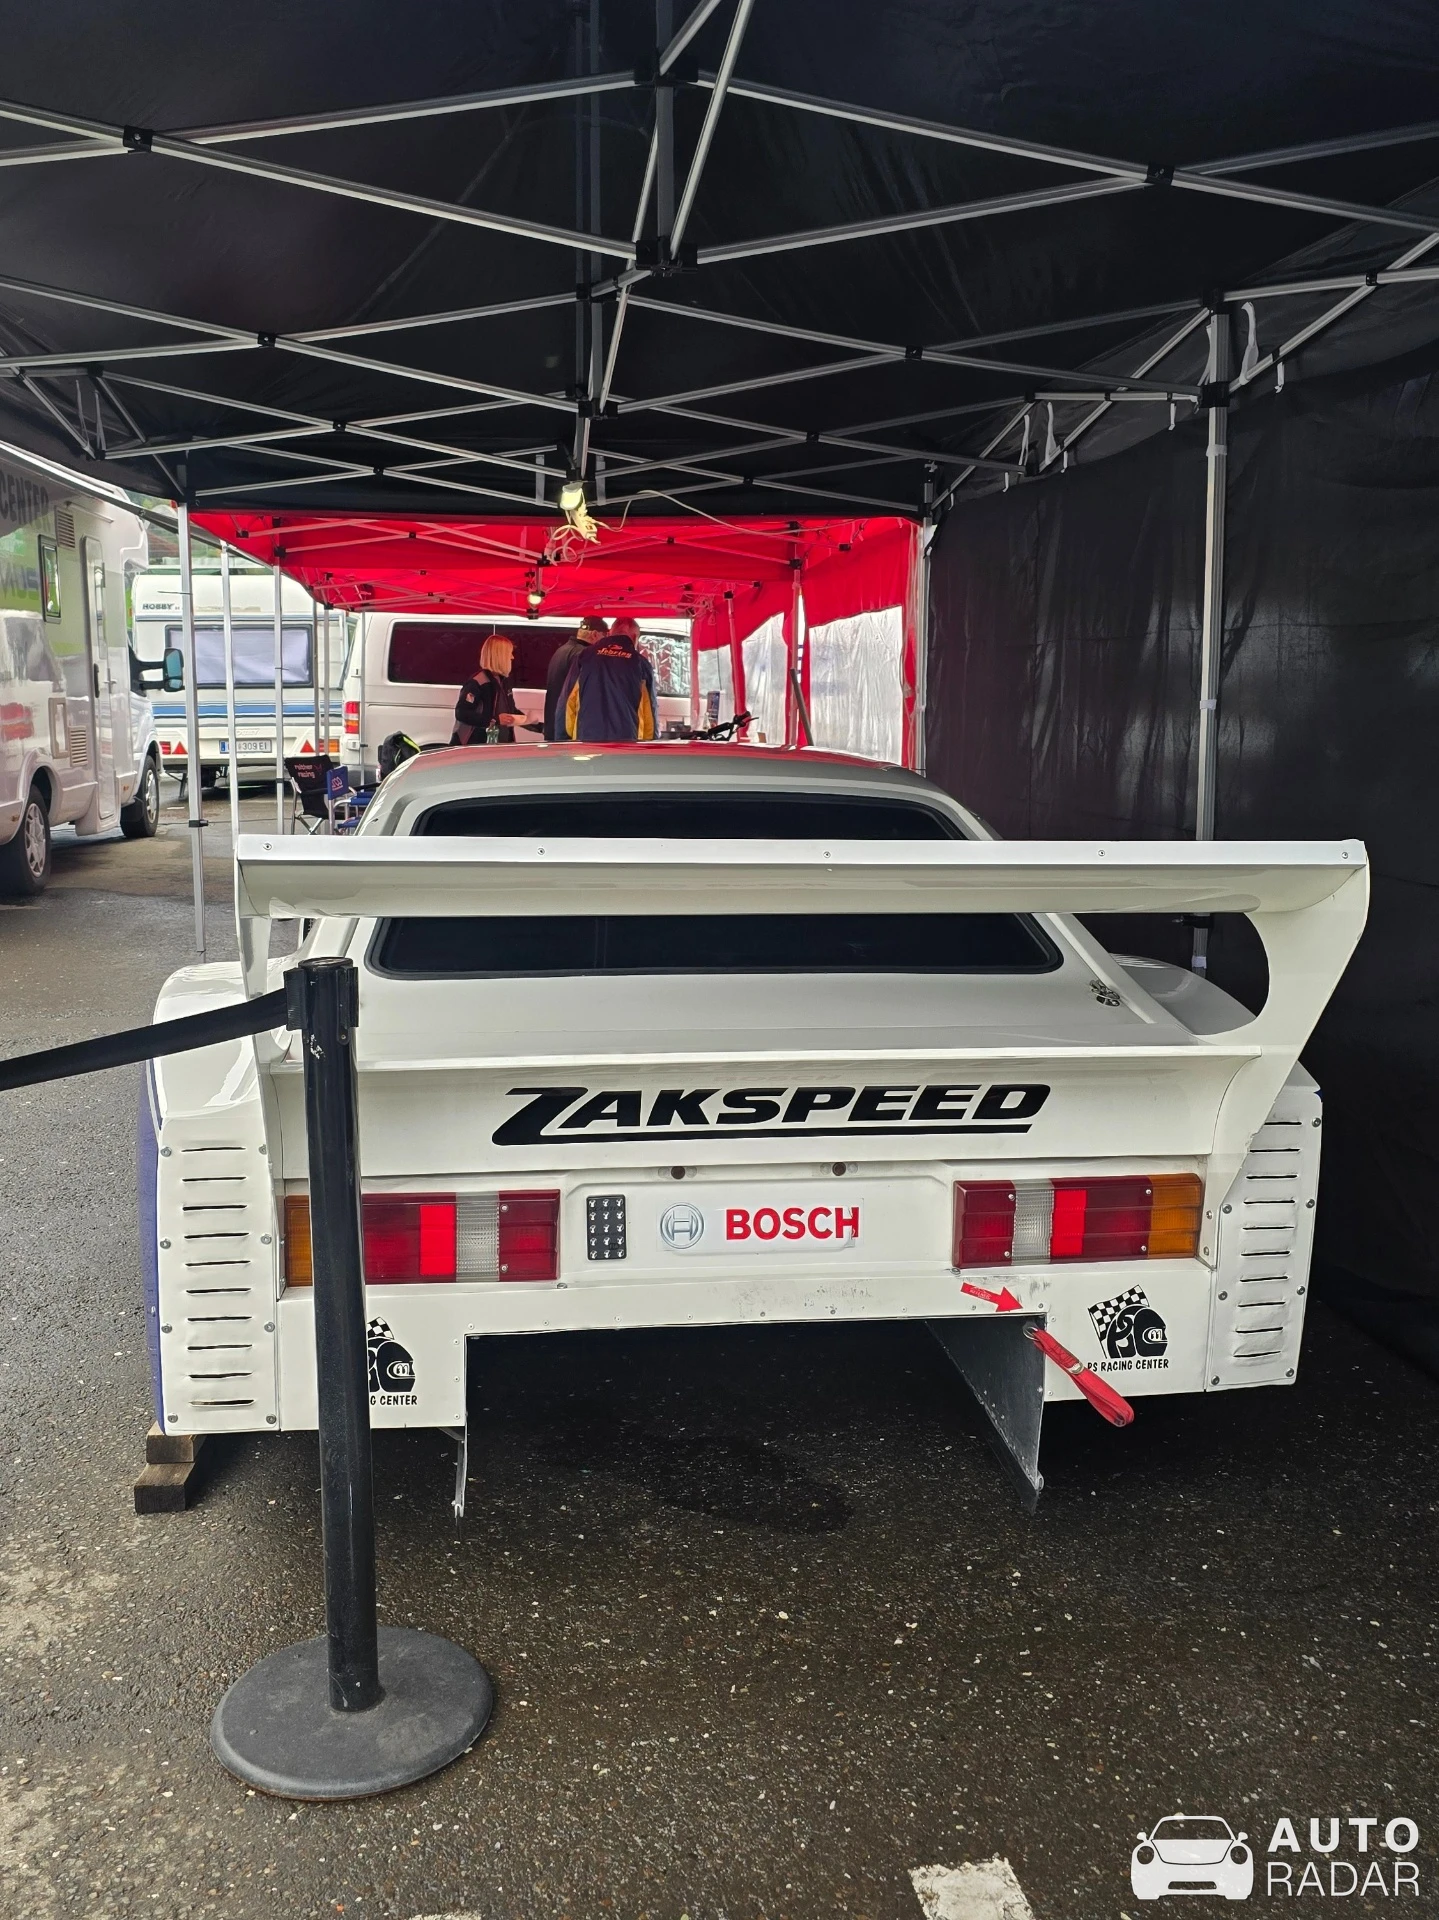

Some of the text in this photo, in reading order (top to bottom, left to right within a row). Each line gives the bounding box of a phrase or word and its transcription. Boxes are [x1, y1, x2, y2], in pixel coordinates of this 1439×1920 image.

[242, 742, 257, 751] 309
[492, 1083, 1051, 1146] ZAKSPEED
[726, 1206, 860, 1241] BOSCH
[1087, 1358, 1170, 1373] PS RACING CENTER
[379, 1395, 418, 1406] CENTER
